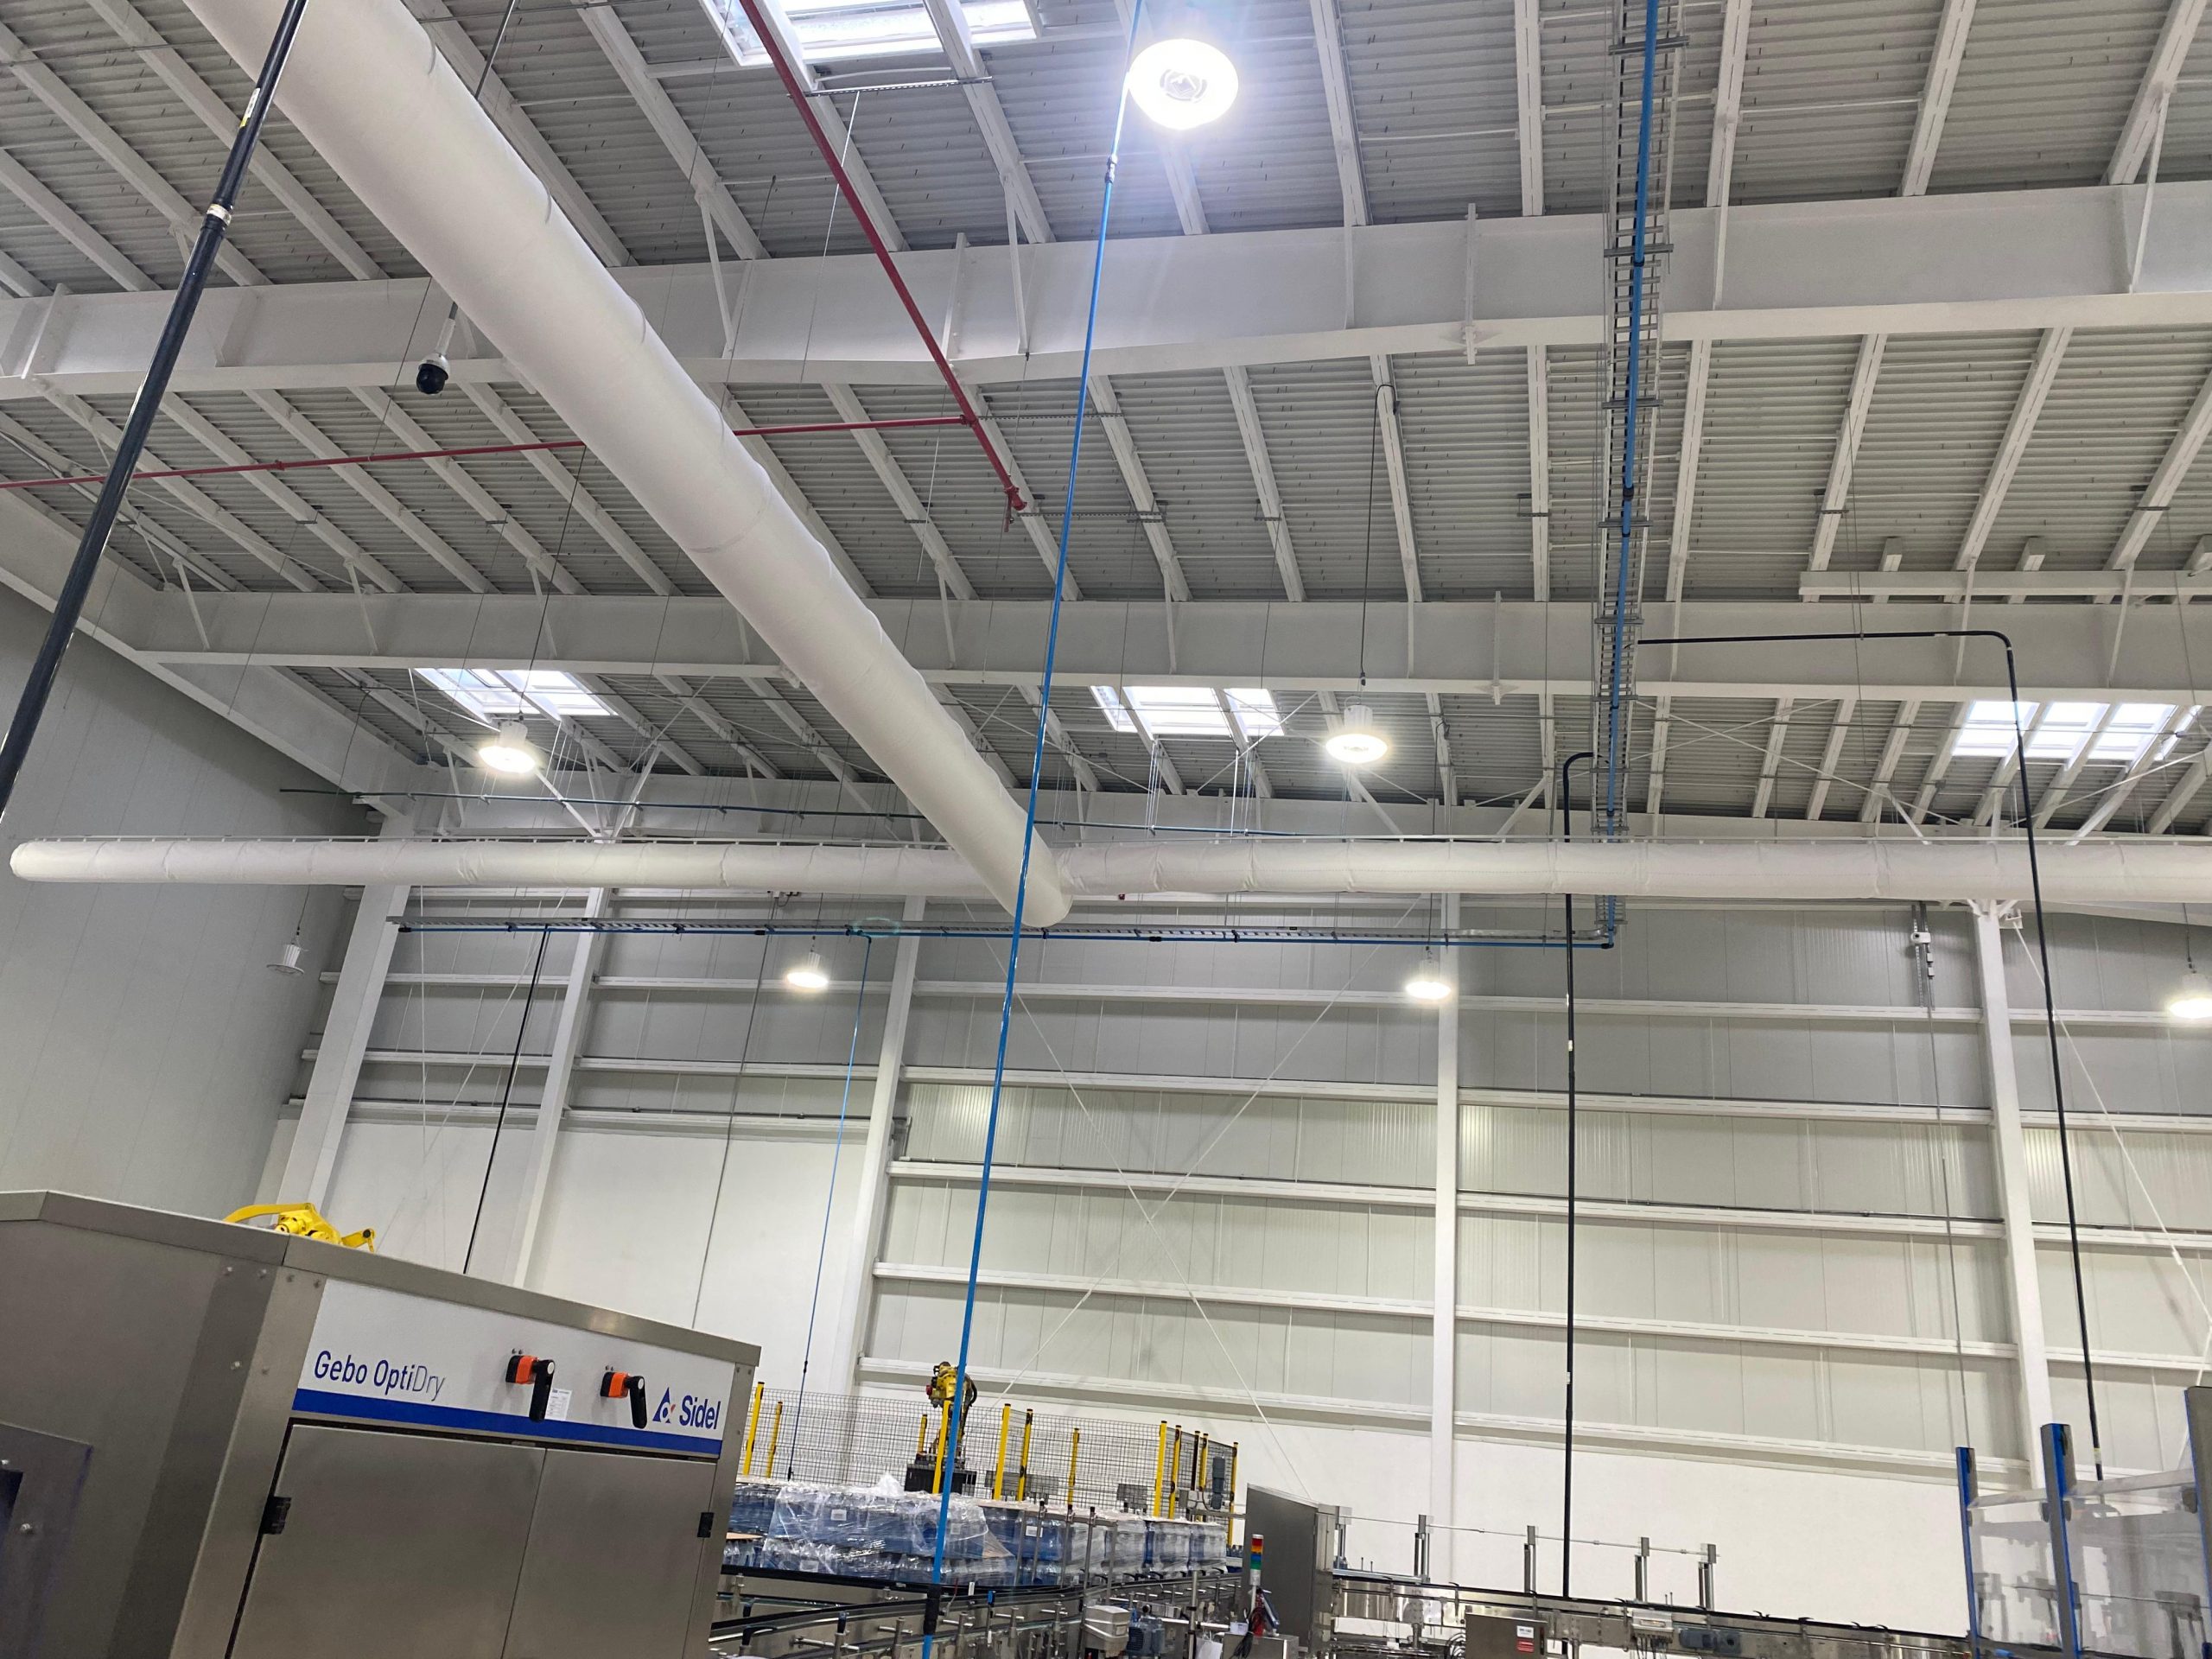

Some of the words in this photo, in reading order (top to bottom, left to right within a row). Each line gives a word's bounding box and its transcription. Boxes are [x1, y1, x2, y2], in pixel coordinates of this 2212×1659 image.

[314, 1350, 368, 1384] Gebo
[373, 1359, 446, 1402] OptiDry
[679, 1395, 721, 1430] Sidel
